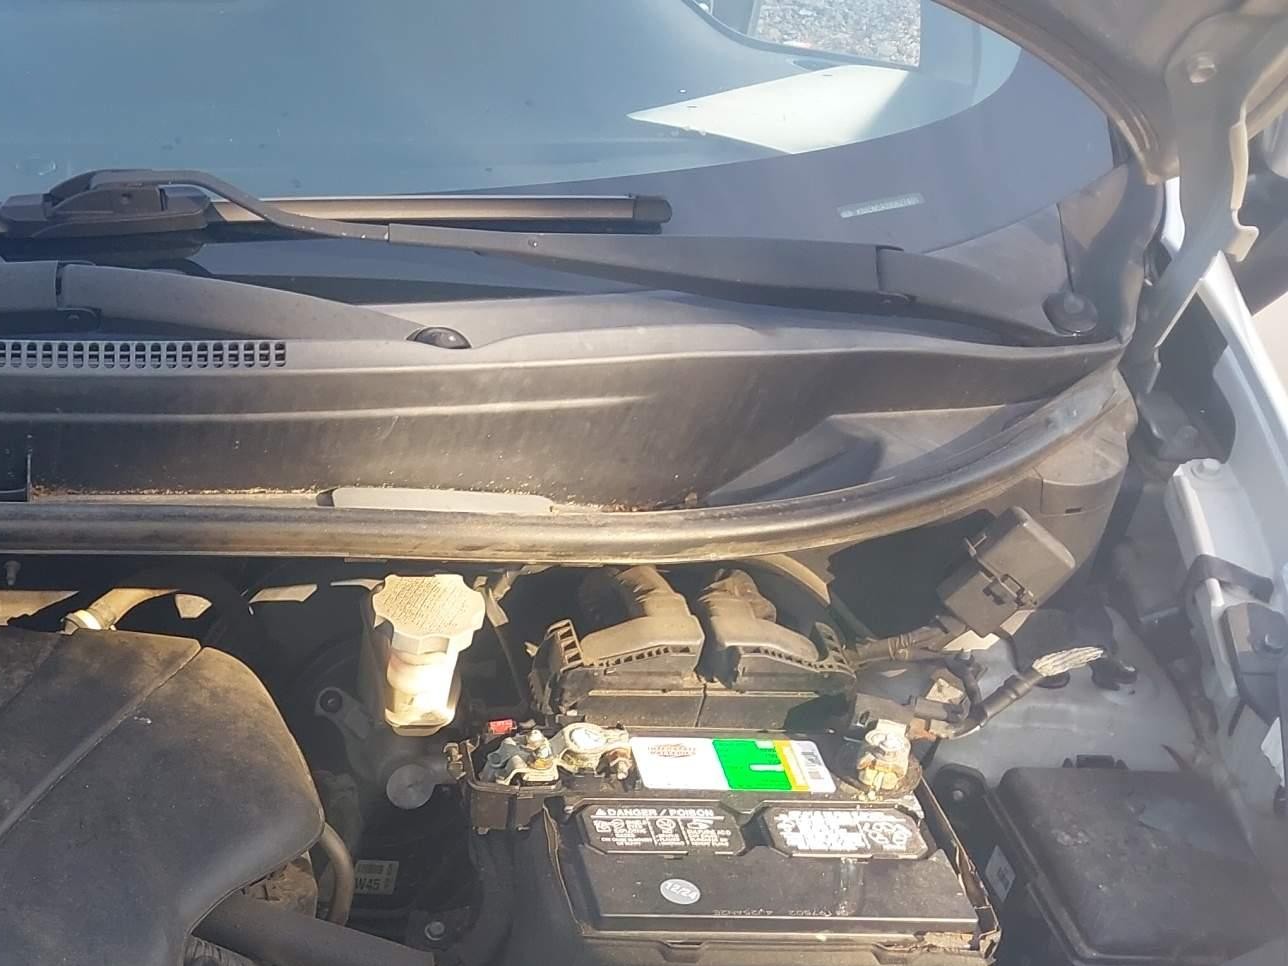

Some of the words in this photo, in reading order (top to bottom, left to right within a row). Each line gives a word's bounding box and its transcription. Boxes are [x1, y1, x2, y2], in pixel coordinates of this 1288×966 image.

[607, 808, 658, 817] DANGER
[669, 808, 714, 817] POISON
[663, 880, 697, 900] 12/24
